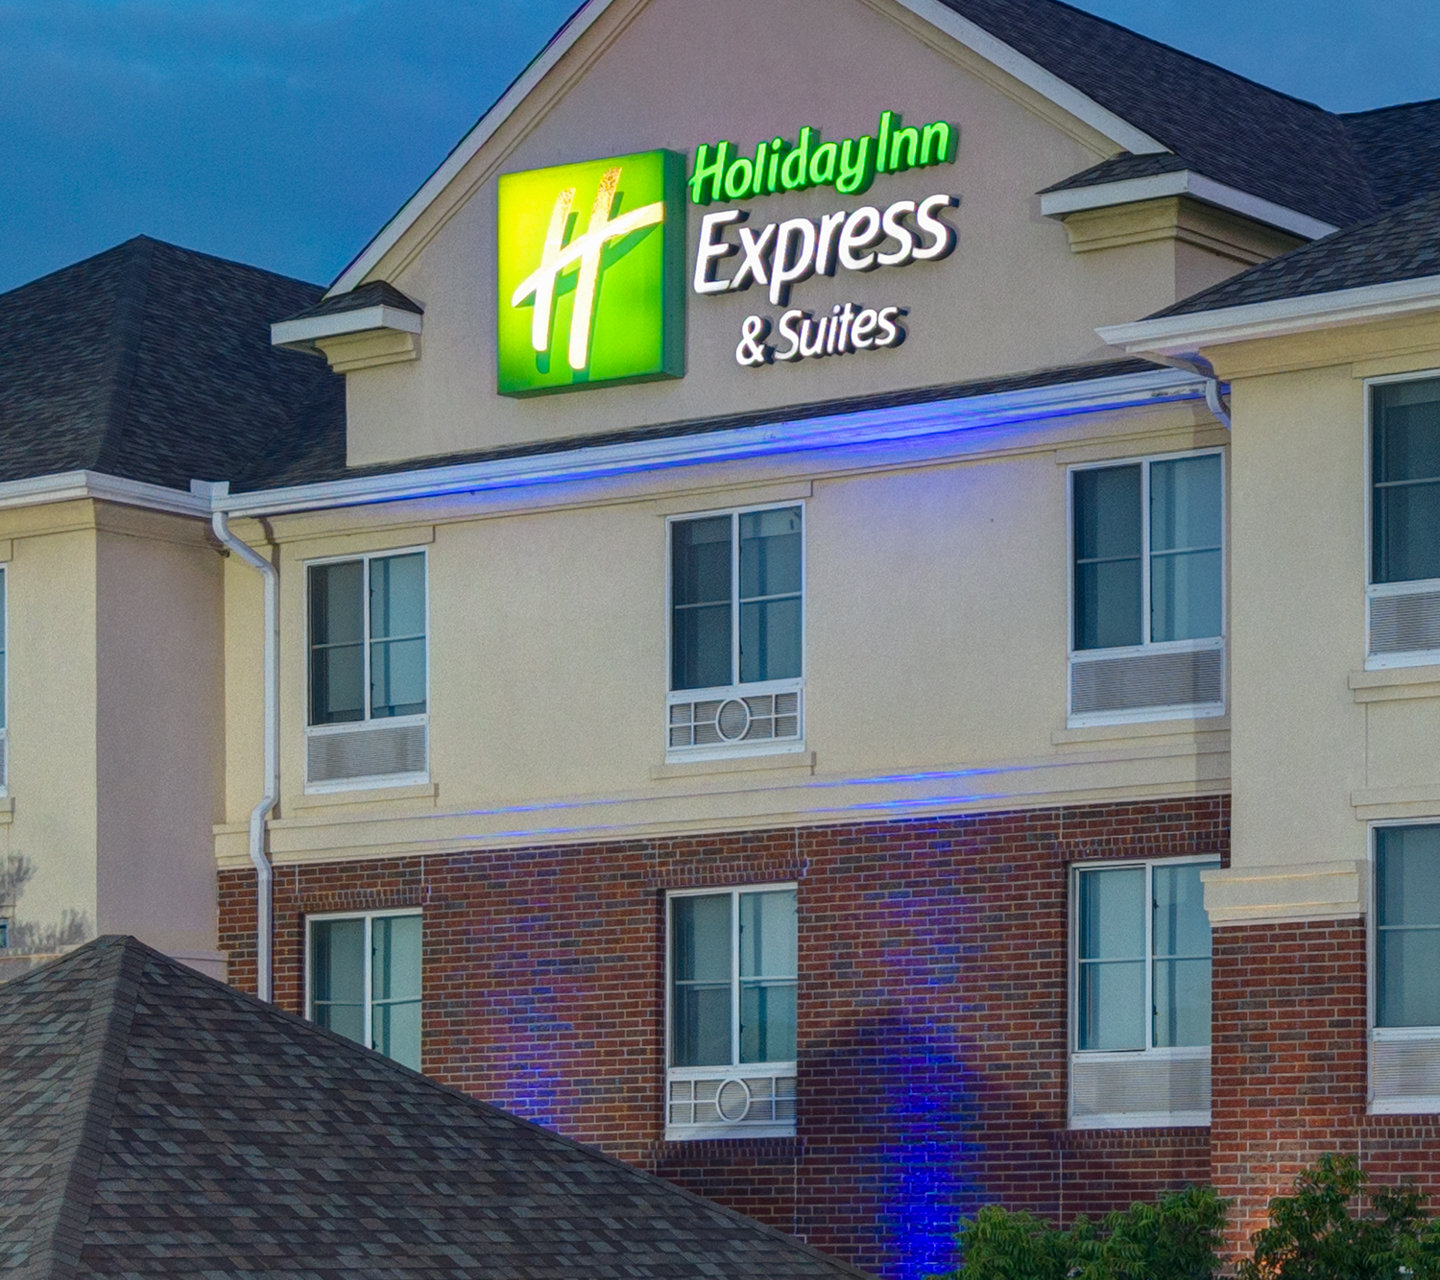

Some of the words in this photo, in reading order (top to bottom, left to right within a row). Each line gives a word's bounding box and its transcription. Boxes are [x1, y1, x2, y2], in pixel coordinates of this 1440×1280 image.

[688, 126, 874, 205] Holiday
[877, 110, 955, 174] Inn
[693, 193, 958, 306] Express
[735, 314, 772, 368] &
[775, 304, 906, 362] Suites
